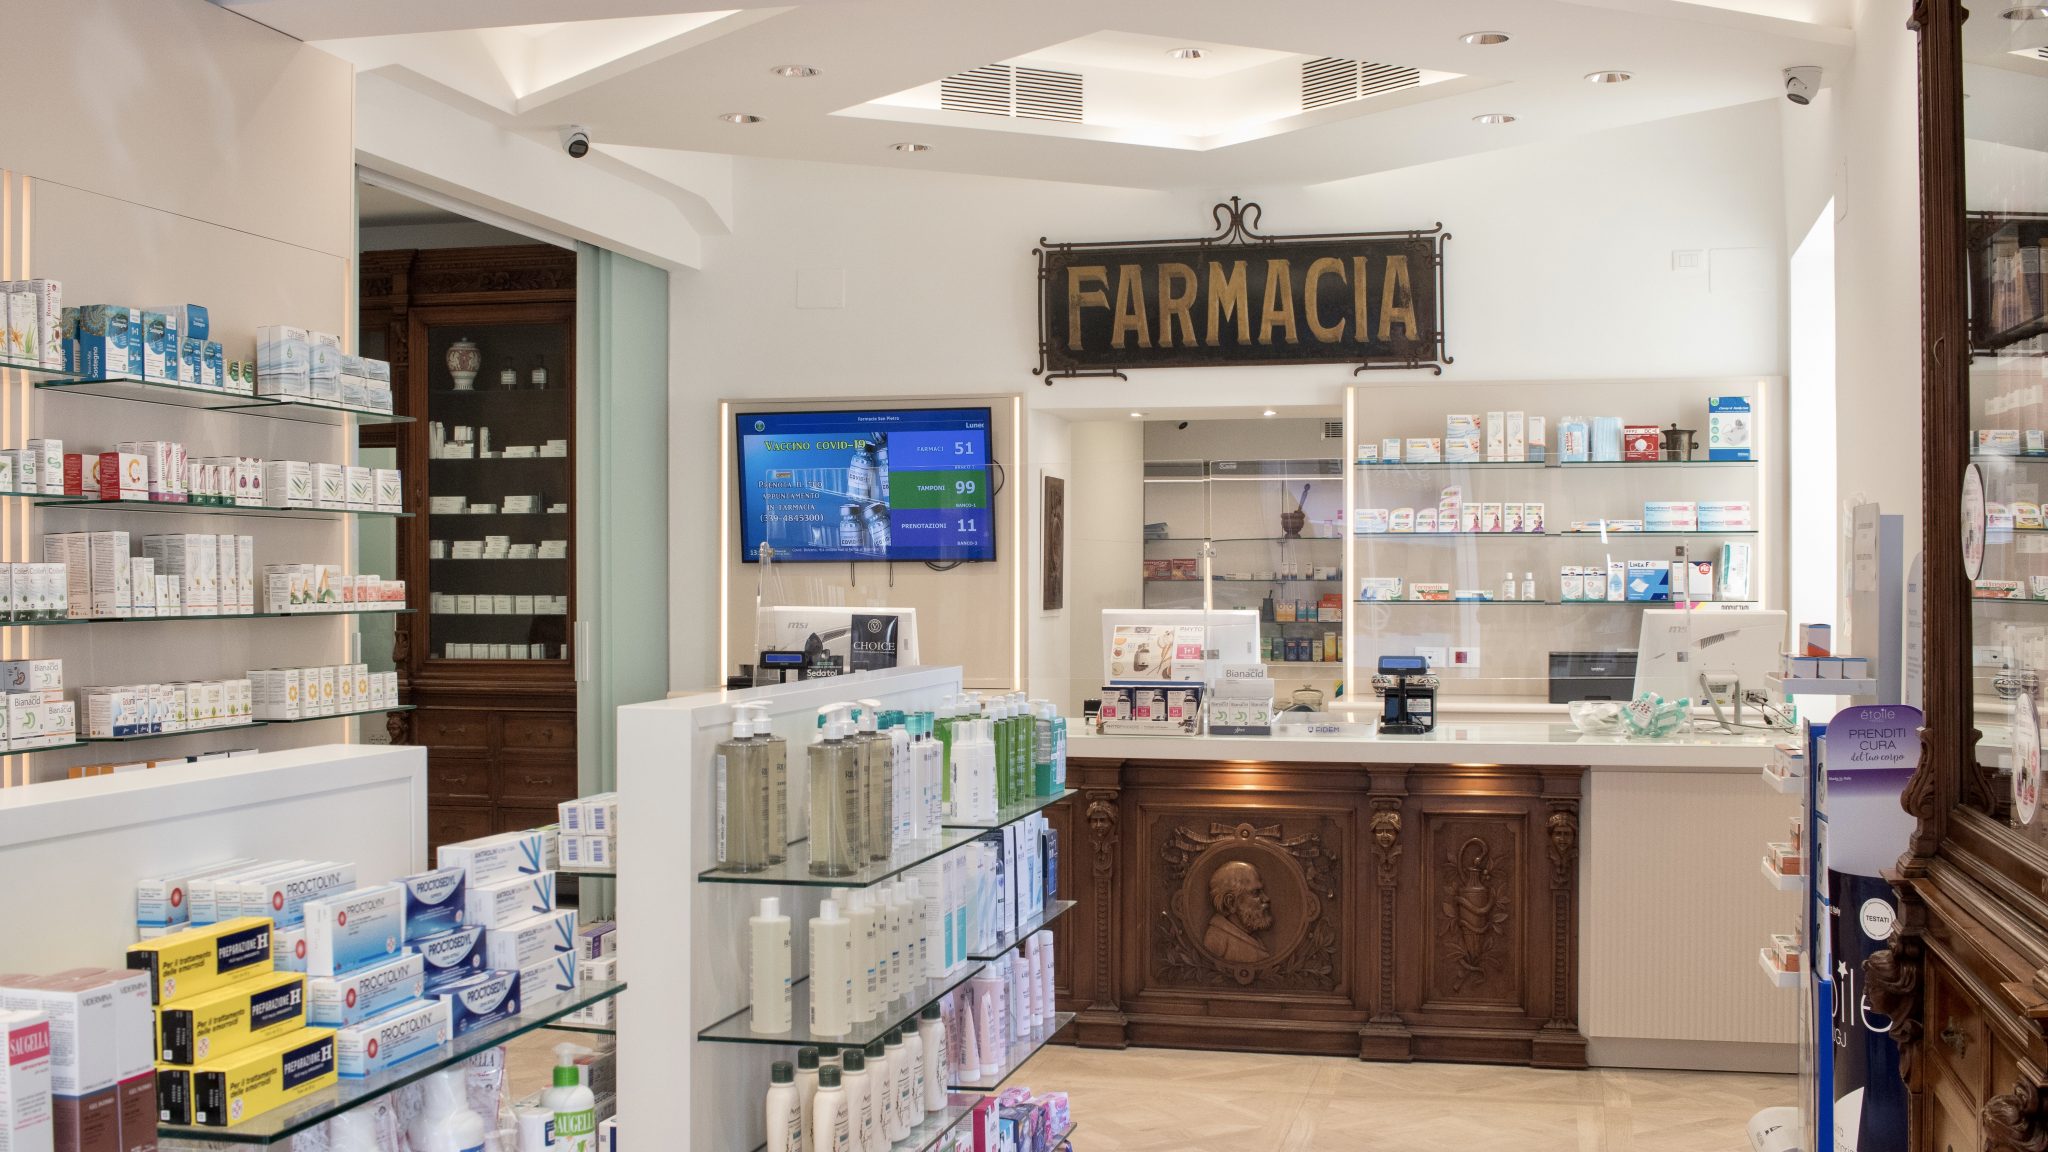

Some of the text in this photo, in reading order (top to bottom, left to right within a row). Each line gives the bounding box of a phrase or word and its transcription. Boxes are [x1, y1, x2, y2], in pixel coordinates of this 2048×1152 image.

[1066, 255, 1419, 351] FARMACIA
[92, 346, 100, 379] Sostegno
[816, 439, 867, 450] COVID-19
[954, 441, 974, 455] 51
[955, 480, 976, 494] 99
[957, 518, 977, 532] 11
[853, 641, 896, 651] CHOICE
[34, 663, 59, 672] Bianacid
[806, 669, 838, 677] Sedatol
[1225, 669, 1264, 678] Bianacid
[14, 697, 41, 707] Bianacid
[1860, 708, 1896, 720] étoile
[1848, 727, 1906, 739] PRENDITI
[1859, 739, 1897, 751] CURA
[286, 872, 340, 896] PROCTOLYN
[416, 874, 457, 894] PROCTOSEDYL
[346, 898, 385, 915] PROCTOLYN
[1865, 914, 1890, 924] TESTATI
[218, 937, 258, 959] PREPARAZIONE
[257, 932, 269, 950] H
[428, 934, 472, 957] PROCTOSEDYL
[162, 960, 173, 970] Per
[180, 951, 212, 966] trattamento
[162, 961, 206, 978] delle emorroidi
[359, 965, 409, 993] PROCTOLYN
[466, 977, 507, 1002] PROCTOSEDYL
[251, 993, 290, 1017] PREPARAZIONE
[290, 988, 302, 1005] H
[197, 1020, 208, 1029] Per
[213, 1008, 245, 1024] trattamento
[197, 1018, 239, 1037] delle emorroidi
[380, 1013, 433, 1042] PROCTOLYN
[9, 1030, 49, 1057] SAUGELLA
[283, 1050, 322, 1074] PREPARAZIONE
[320, 1043, 333, 1063] H
[230, 1081, 240, 1091] Per
[246, 1067, 278, 1085] trattamento
[230, 1077, 272, 1098] delle emorroidi
[555, 1111, 593, 1133] AUGELL
